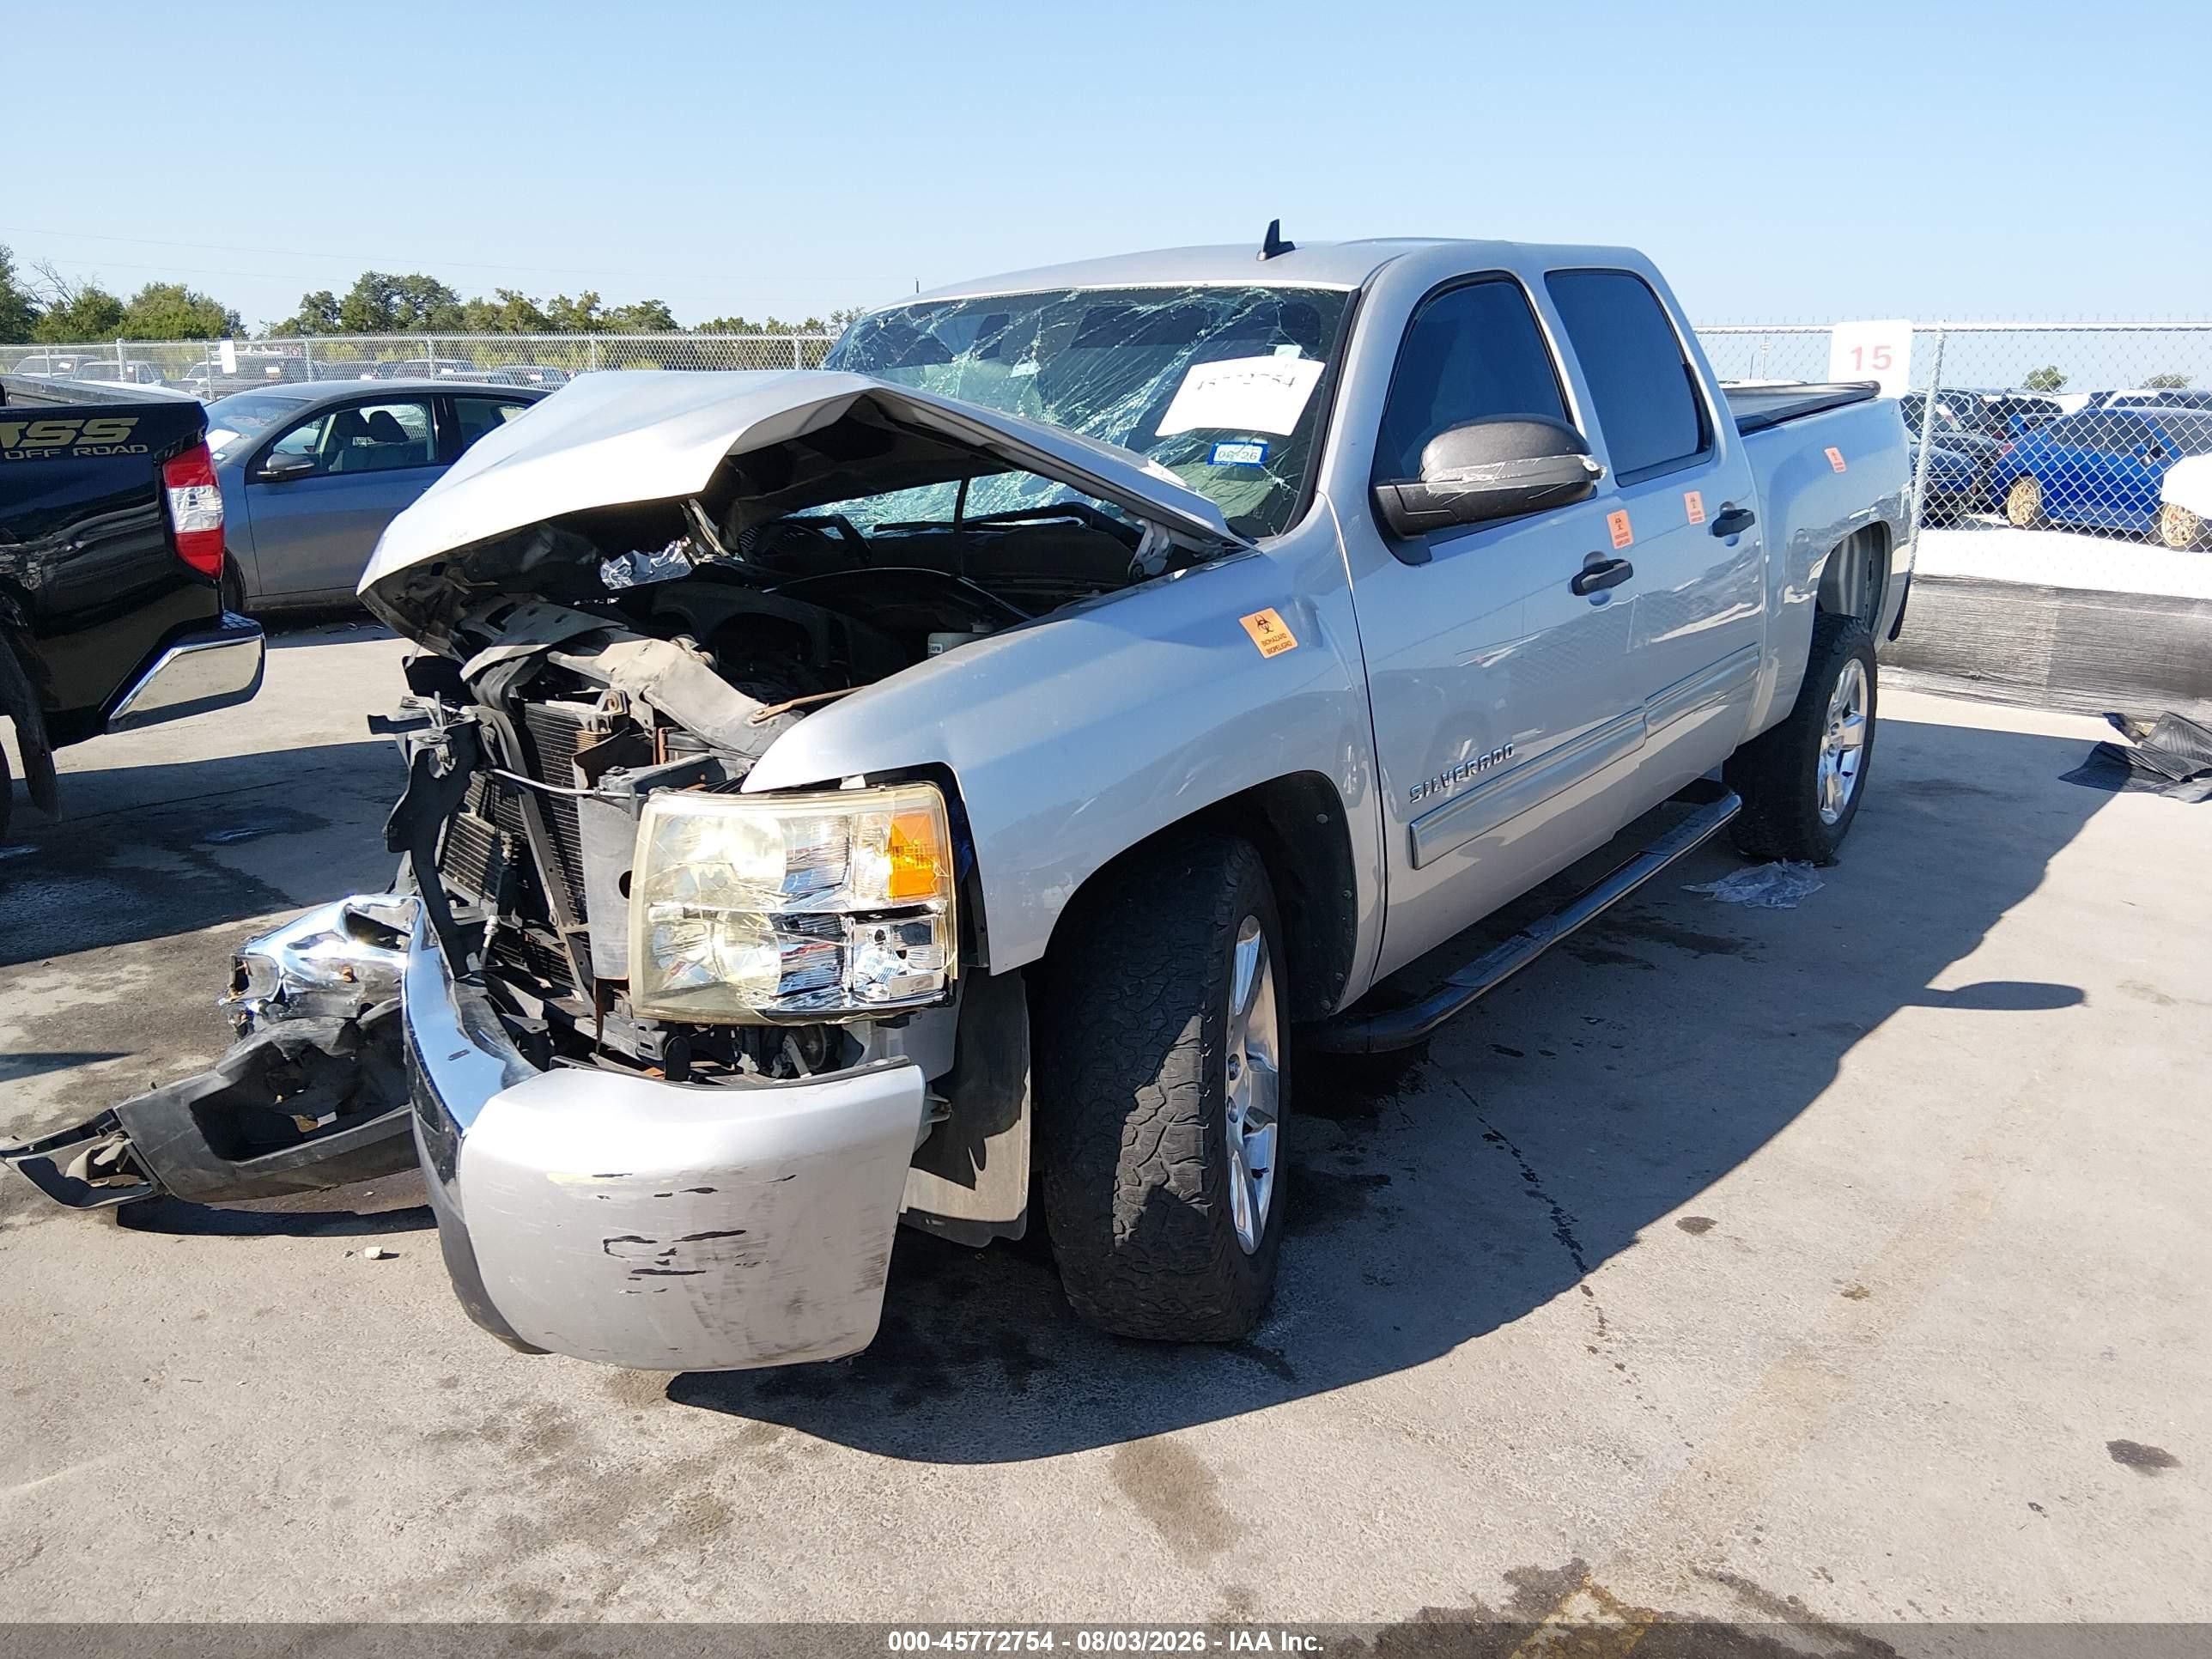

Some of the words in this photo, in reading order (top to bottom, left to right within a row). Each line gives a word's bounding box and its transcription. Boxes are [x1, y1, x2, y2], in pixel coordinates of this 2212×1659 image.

[1850, 345, 1892, 371] 15
[4, 448, 62, 459] OFF
[73, 444, 149, 457] ROAD
[1410, 742, 1515, 804] SILVERADO
